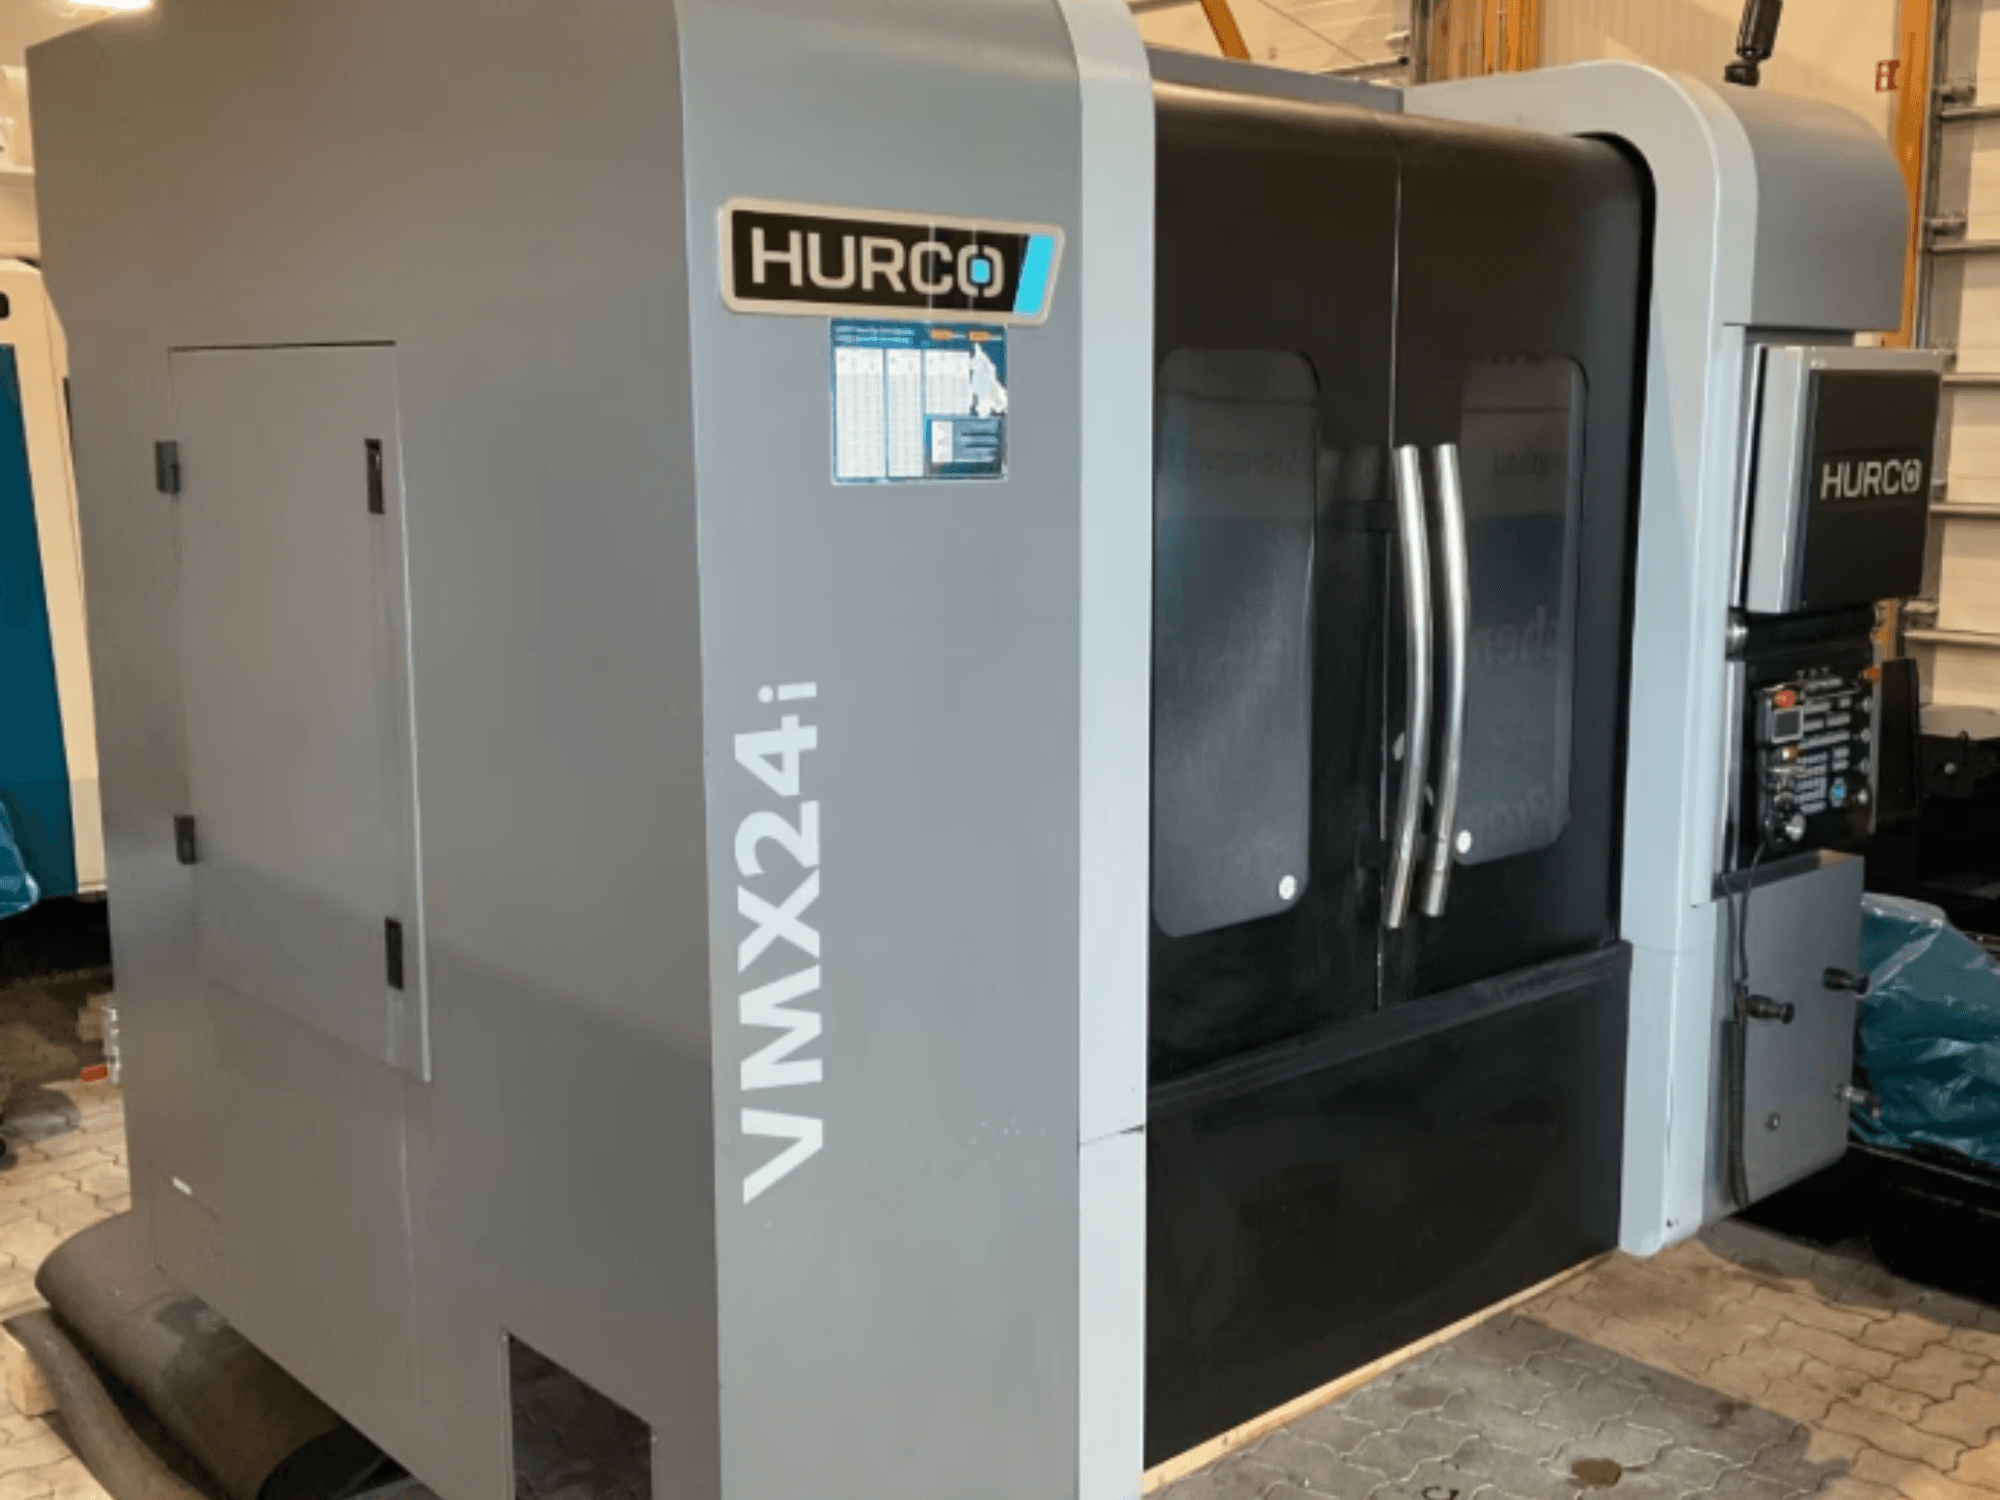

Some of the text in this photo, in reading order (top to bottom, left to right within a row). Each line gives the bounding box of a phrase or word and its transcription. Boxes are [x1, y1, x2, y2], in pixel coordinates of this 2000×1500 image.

[752, 227, 1004, 298] HURCO
[1821, 458, 1922, 499] HURCO
[734, 681, 823, 1206] VMX24i
